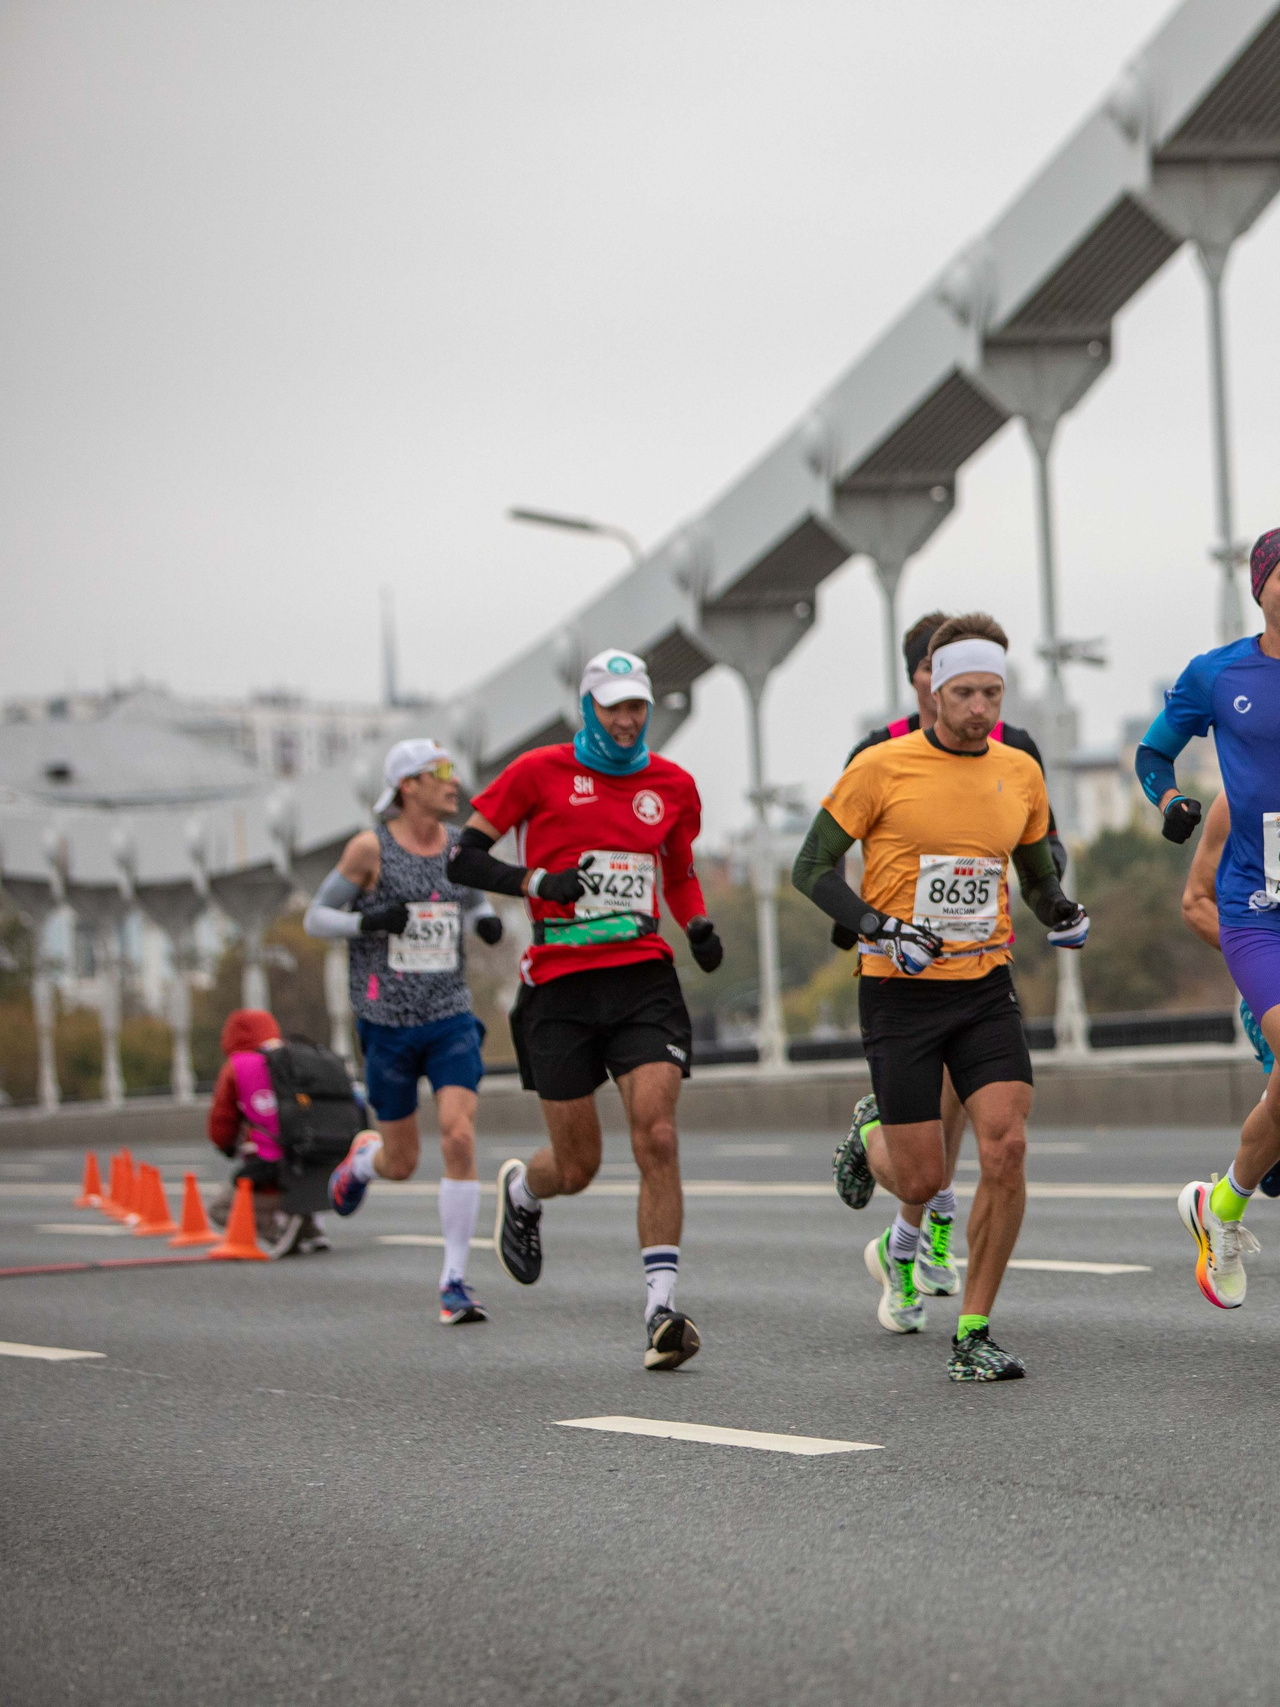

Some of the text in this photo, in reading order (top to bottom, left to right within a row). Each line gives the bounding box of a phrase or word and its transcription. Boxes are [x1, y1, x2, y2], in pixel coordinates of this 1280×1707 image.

[573, 775, 594, 795] SH
[590, 873, 644, 898] 7423
[928, 878, 990, 905] 8635
[942, 907, 975, 915] МАКСИМ
[398, 921, 455, 941] 4591
